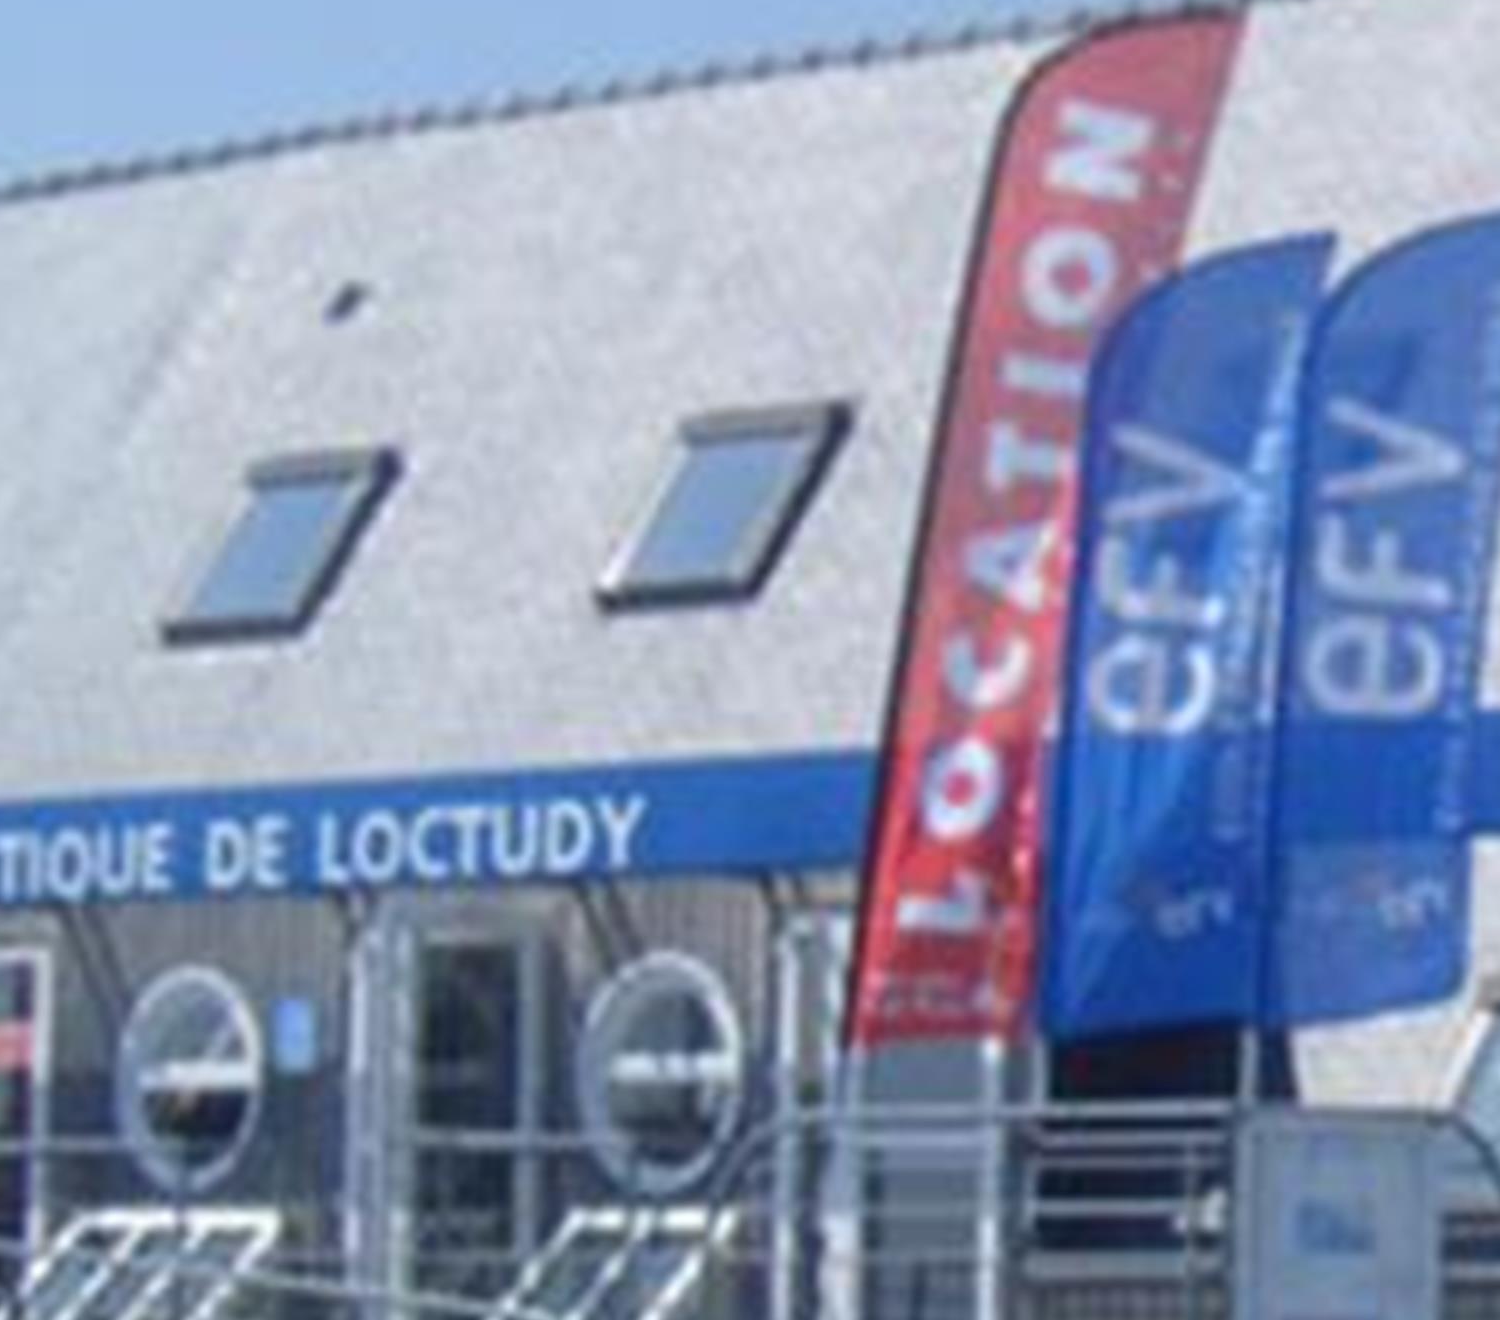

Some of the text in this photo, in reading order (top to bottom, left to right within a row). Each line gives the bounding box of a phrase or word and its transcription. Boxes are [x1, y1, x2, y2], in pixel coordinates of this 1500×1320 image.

[897, 100, 1154, 934] LOCATION
[205, 811, 289, 888] DE
[317, 795, 646, 883] LOCTUDY
